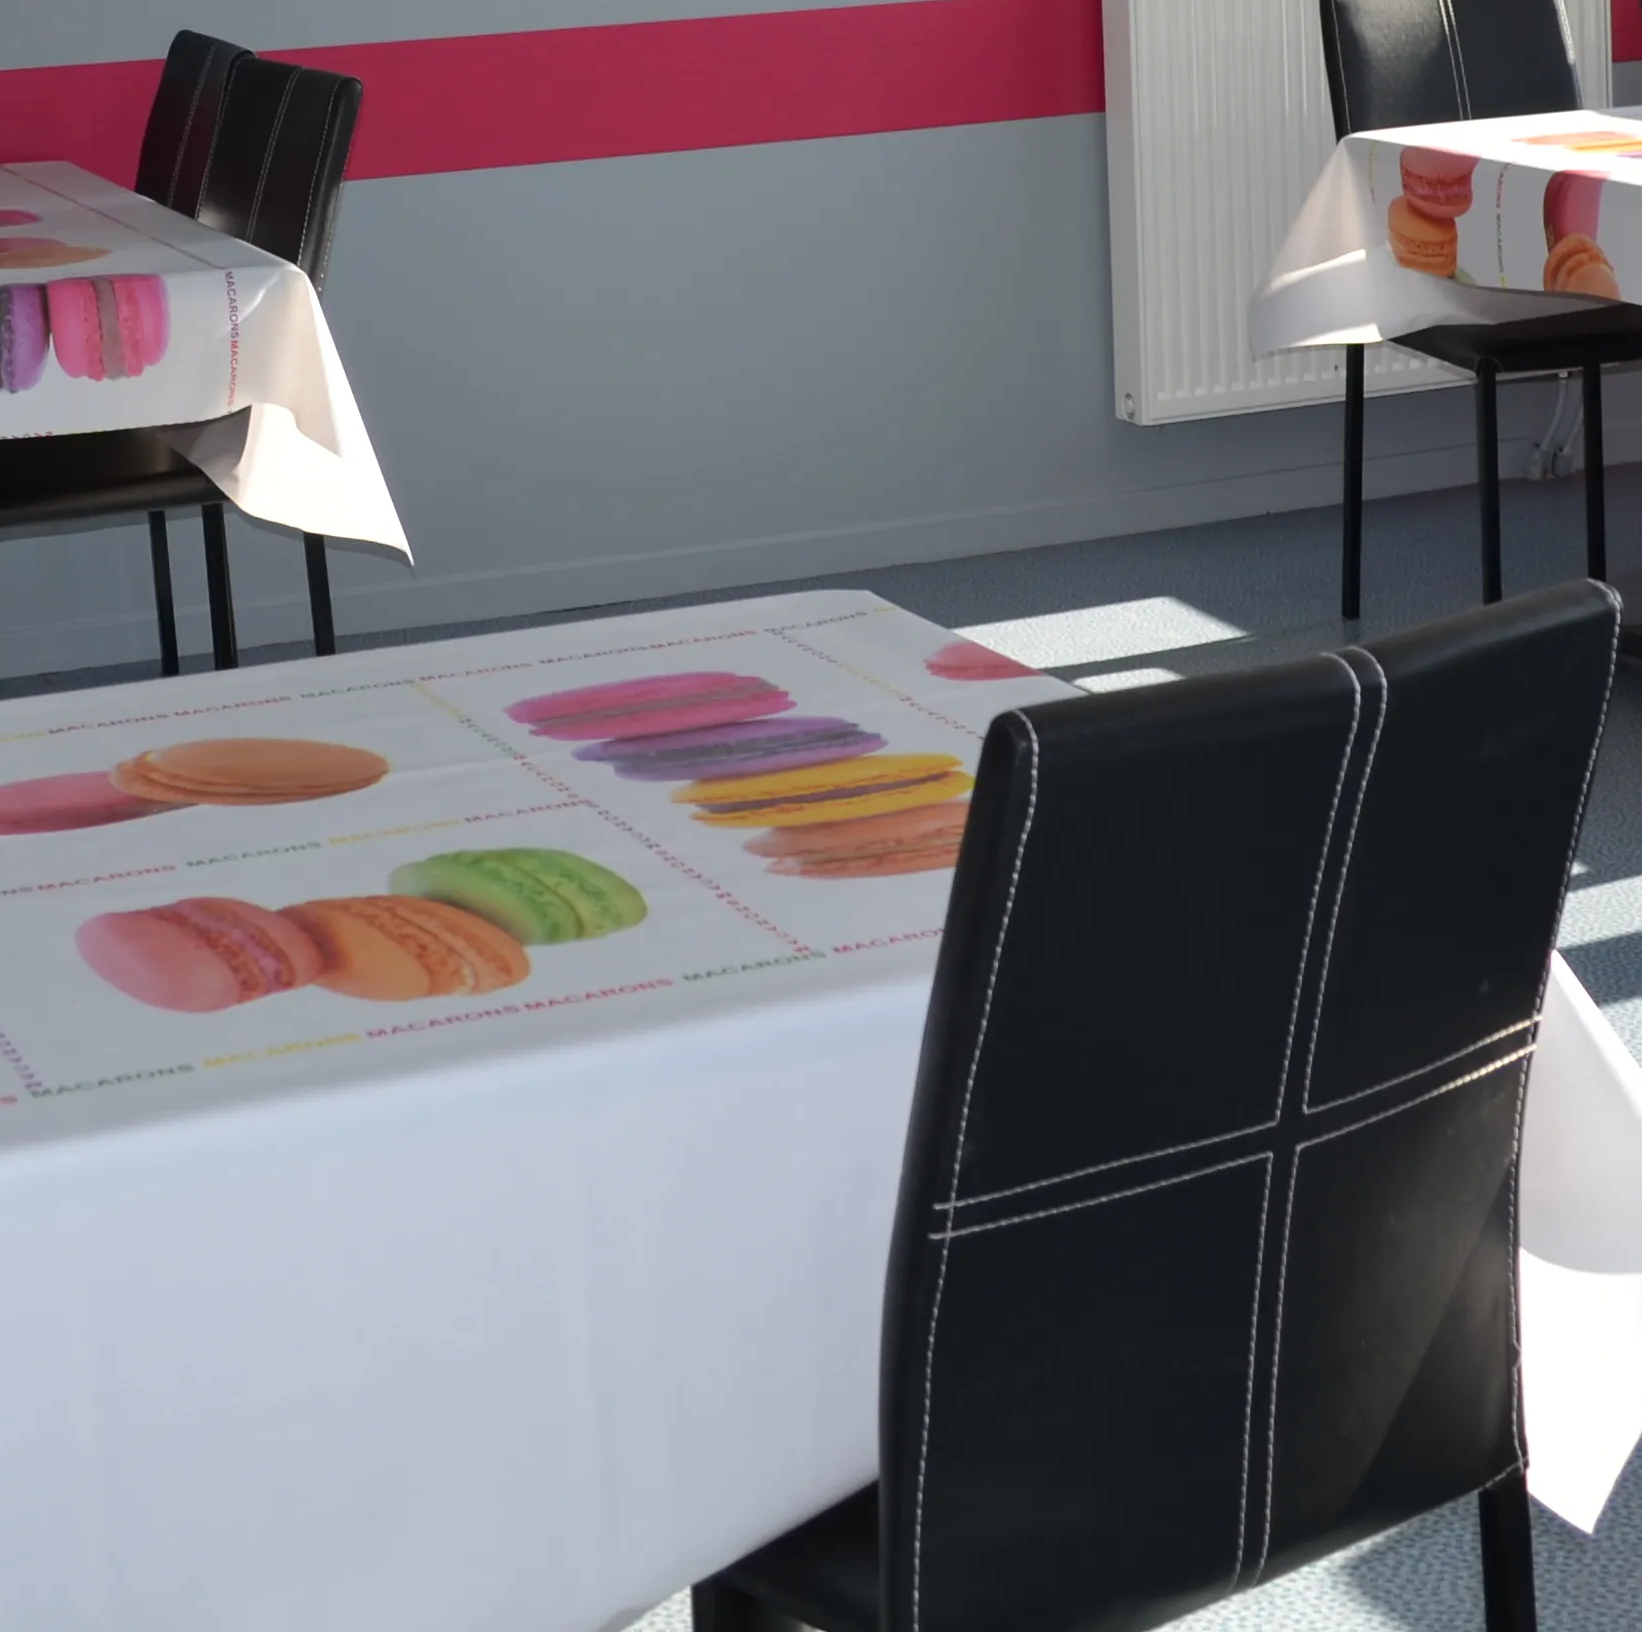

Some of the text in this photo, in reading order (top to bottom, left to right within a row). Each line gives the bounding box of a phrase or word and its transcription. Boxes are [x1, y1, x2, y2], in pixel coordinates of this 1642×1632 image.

[225, 271, 240, 406] MACARONS MACARONS
[47, 713, 170, 736] MACARONS
[172, 695, 293, 718] MACARONS
[417, 662, 534, 683] MACARONS
[36, 863, 177, 892] MACARONS
[184, 840, 323, 869] MACARONS
[29, 1060, 197, 1100] MACARONS
[201, 1031, 362, 1069] MACARONS
[363, 1001, 521, 1040] MACARONS
[522, 976, 676, 1014] MACARONS
[679, 948, 828, 984] MACARONS
